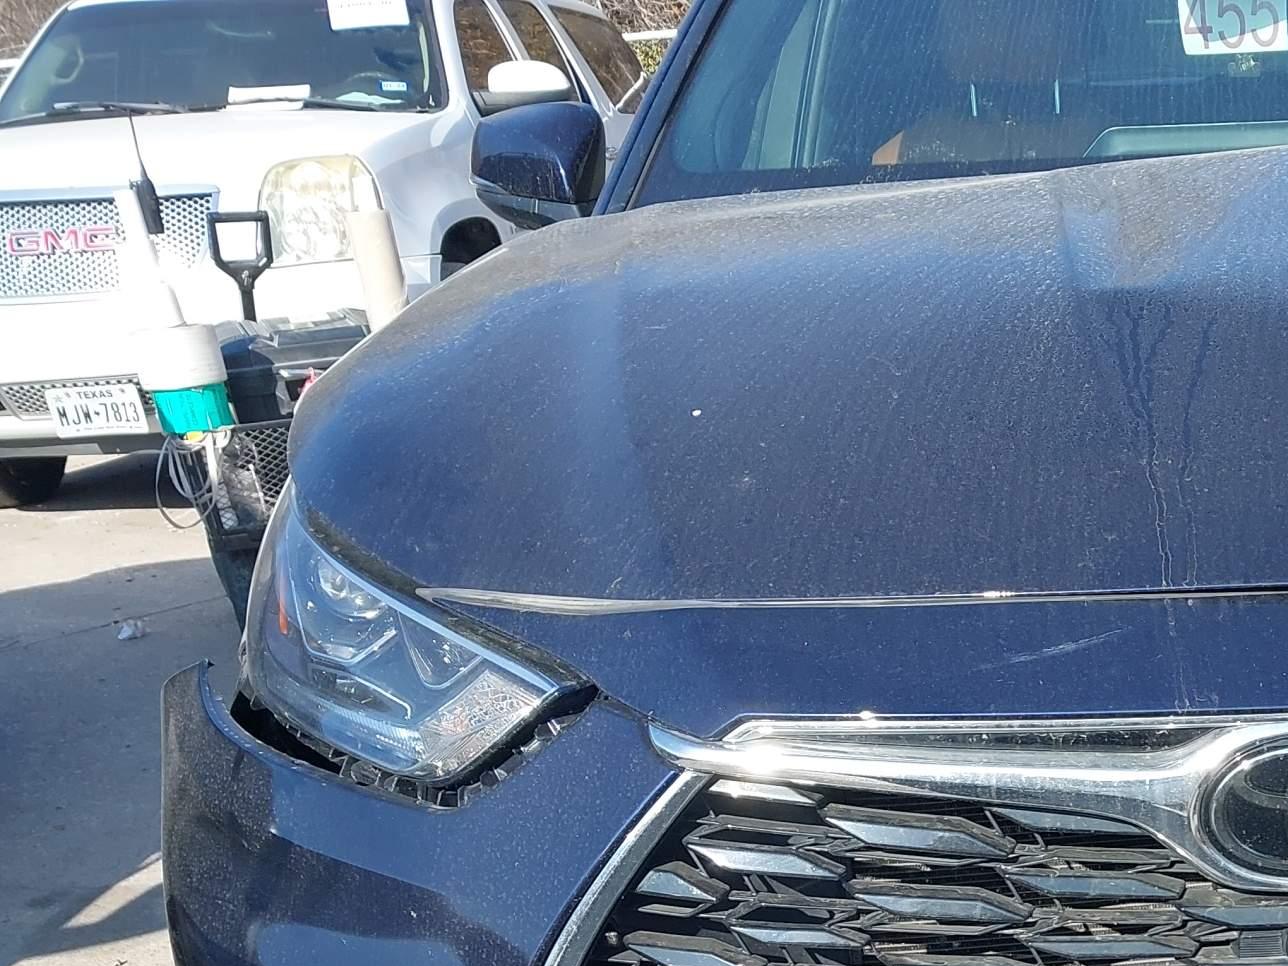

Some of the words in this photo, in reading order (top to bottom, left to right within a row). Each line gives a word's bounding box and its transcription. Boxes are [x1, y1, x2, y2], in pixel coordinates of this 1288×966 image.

[1184, 0, 1280, 49] 455
[8, 226, 116, 256] GMC
[76, 389, 113, 399] TEXAS
